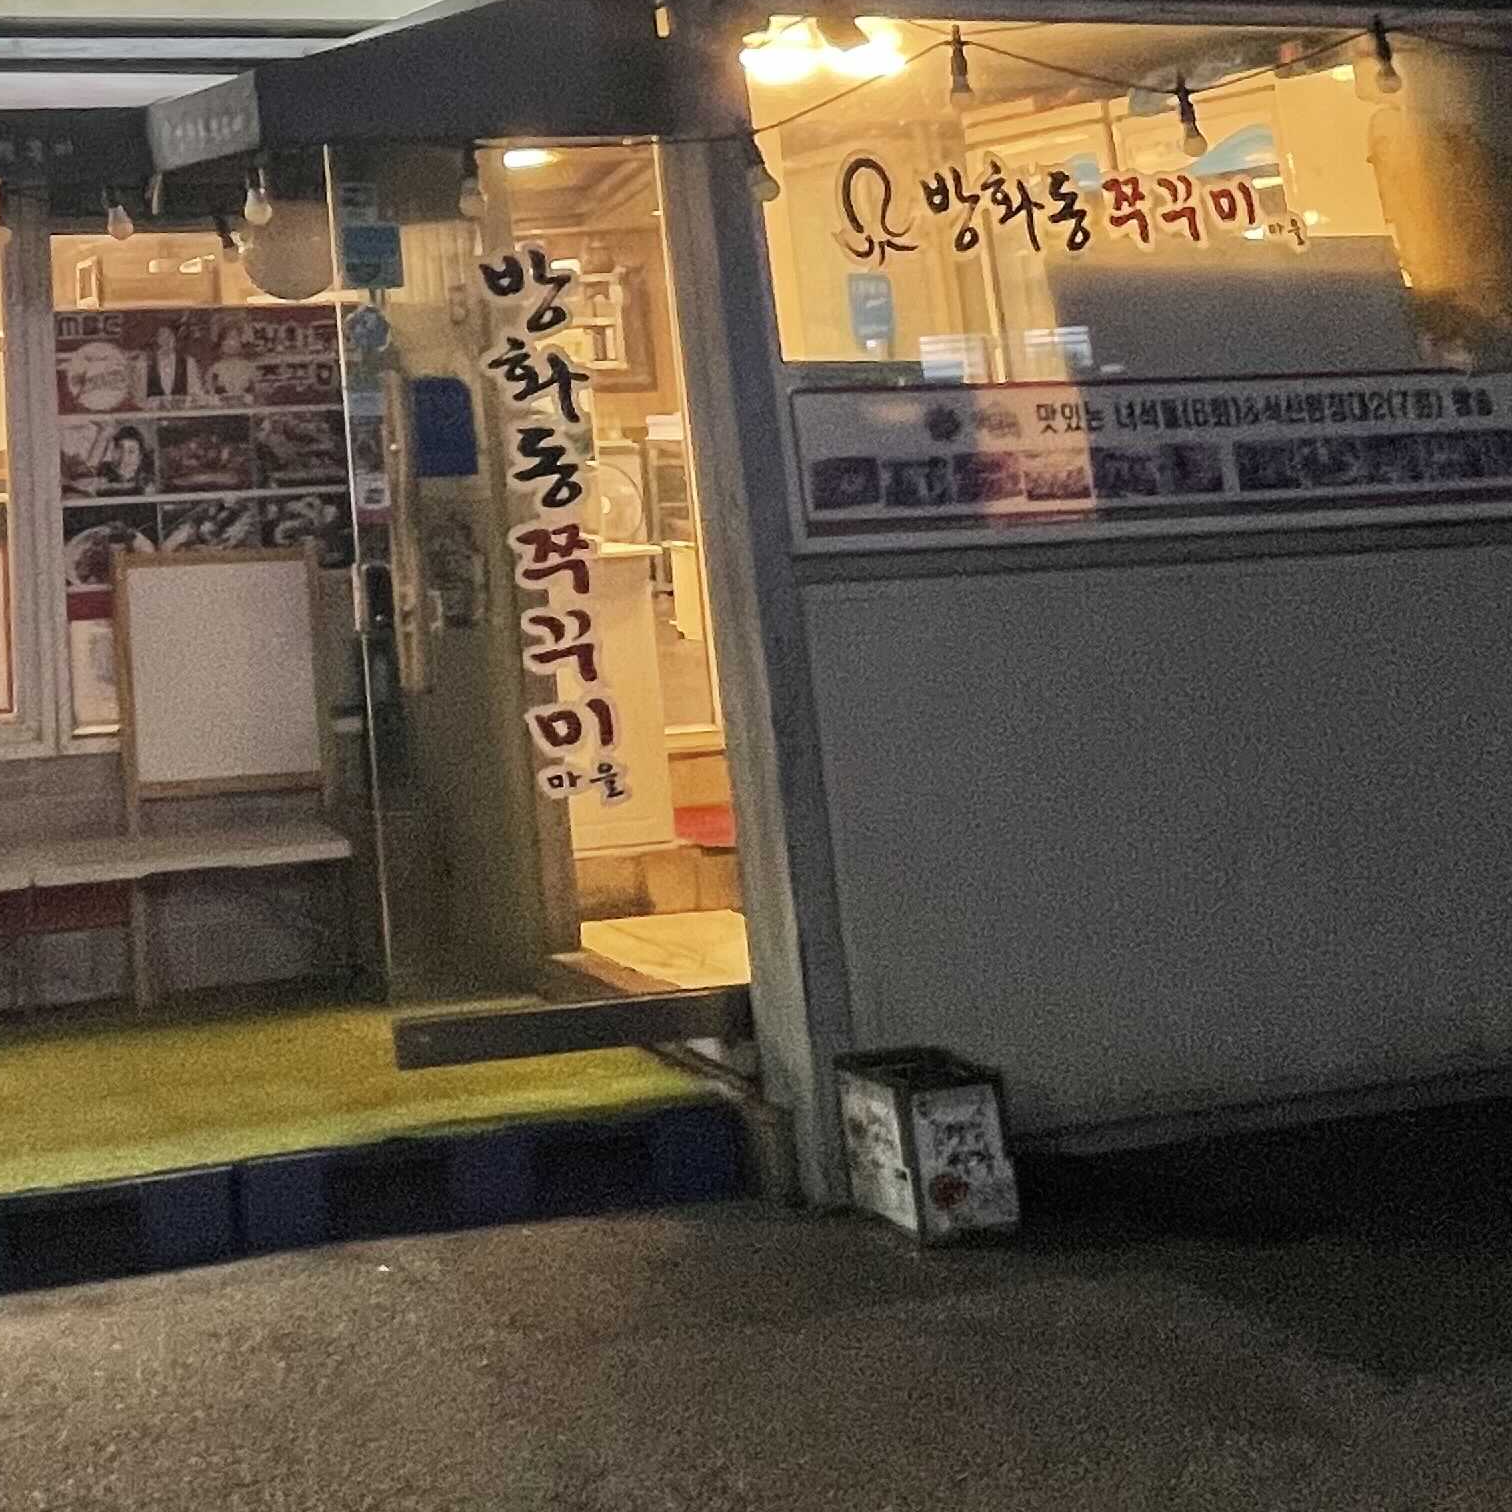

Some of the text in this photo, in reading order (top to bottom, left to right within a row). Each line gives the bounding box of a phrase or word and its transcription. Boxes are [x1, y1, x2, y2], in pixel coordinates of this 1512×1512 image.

[920, 160, 1092, 252] 방화동
[1102, 173, 1257, 243] 쭈꾸미
[481, 248, 588, 508] 방화동
[1035, 401, 1107, 435] 맛있는
